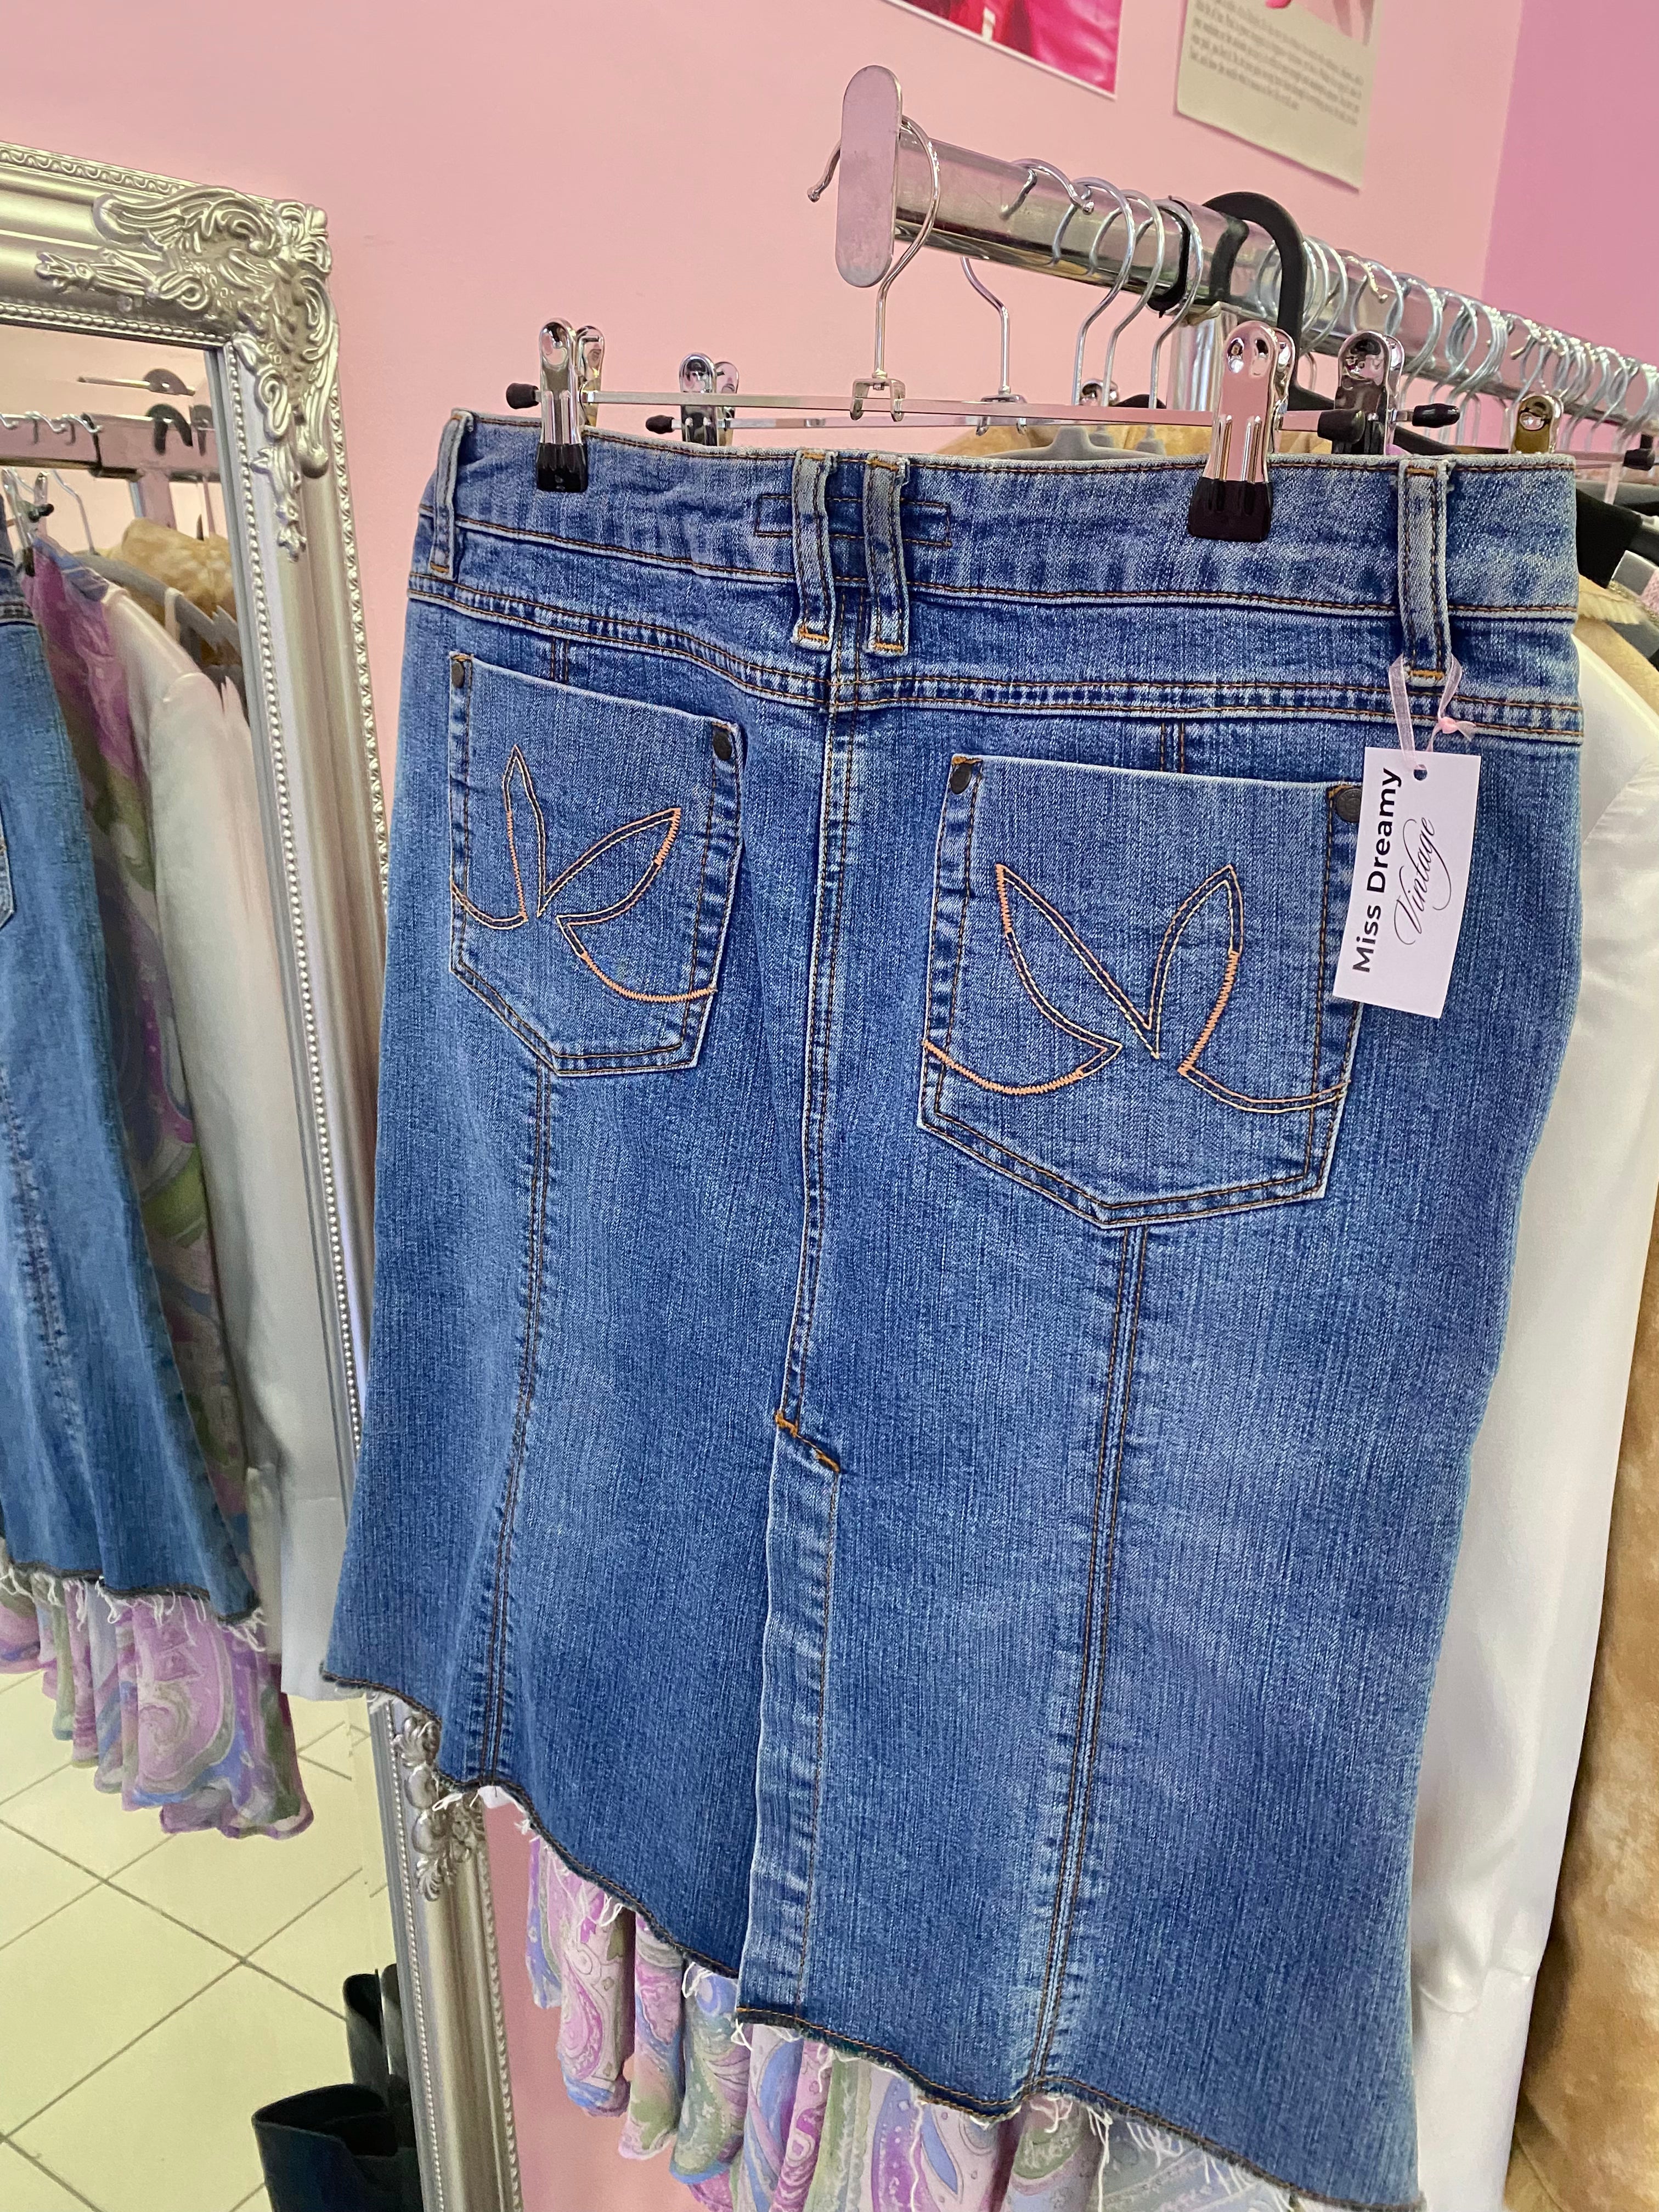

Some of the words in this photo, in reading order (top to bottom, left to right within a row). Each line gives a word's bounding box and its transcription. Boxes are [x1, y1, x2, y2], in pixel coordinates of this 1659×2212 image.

[1352, 905, 1382, 973] Miss
[1367, 768, 1402, 893] Dreamy
[1394, 817, 1452, 945] Vintage
